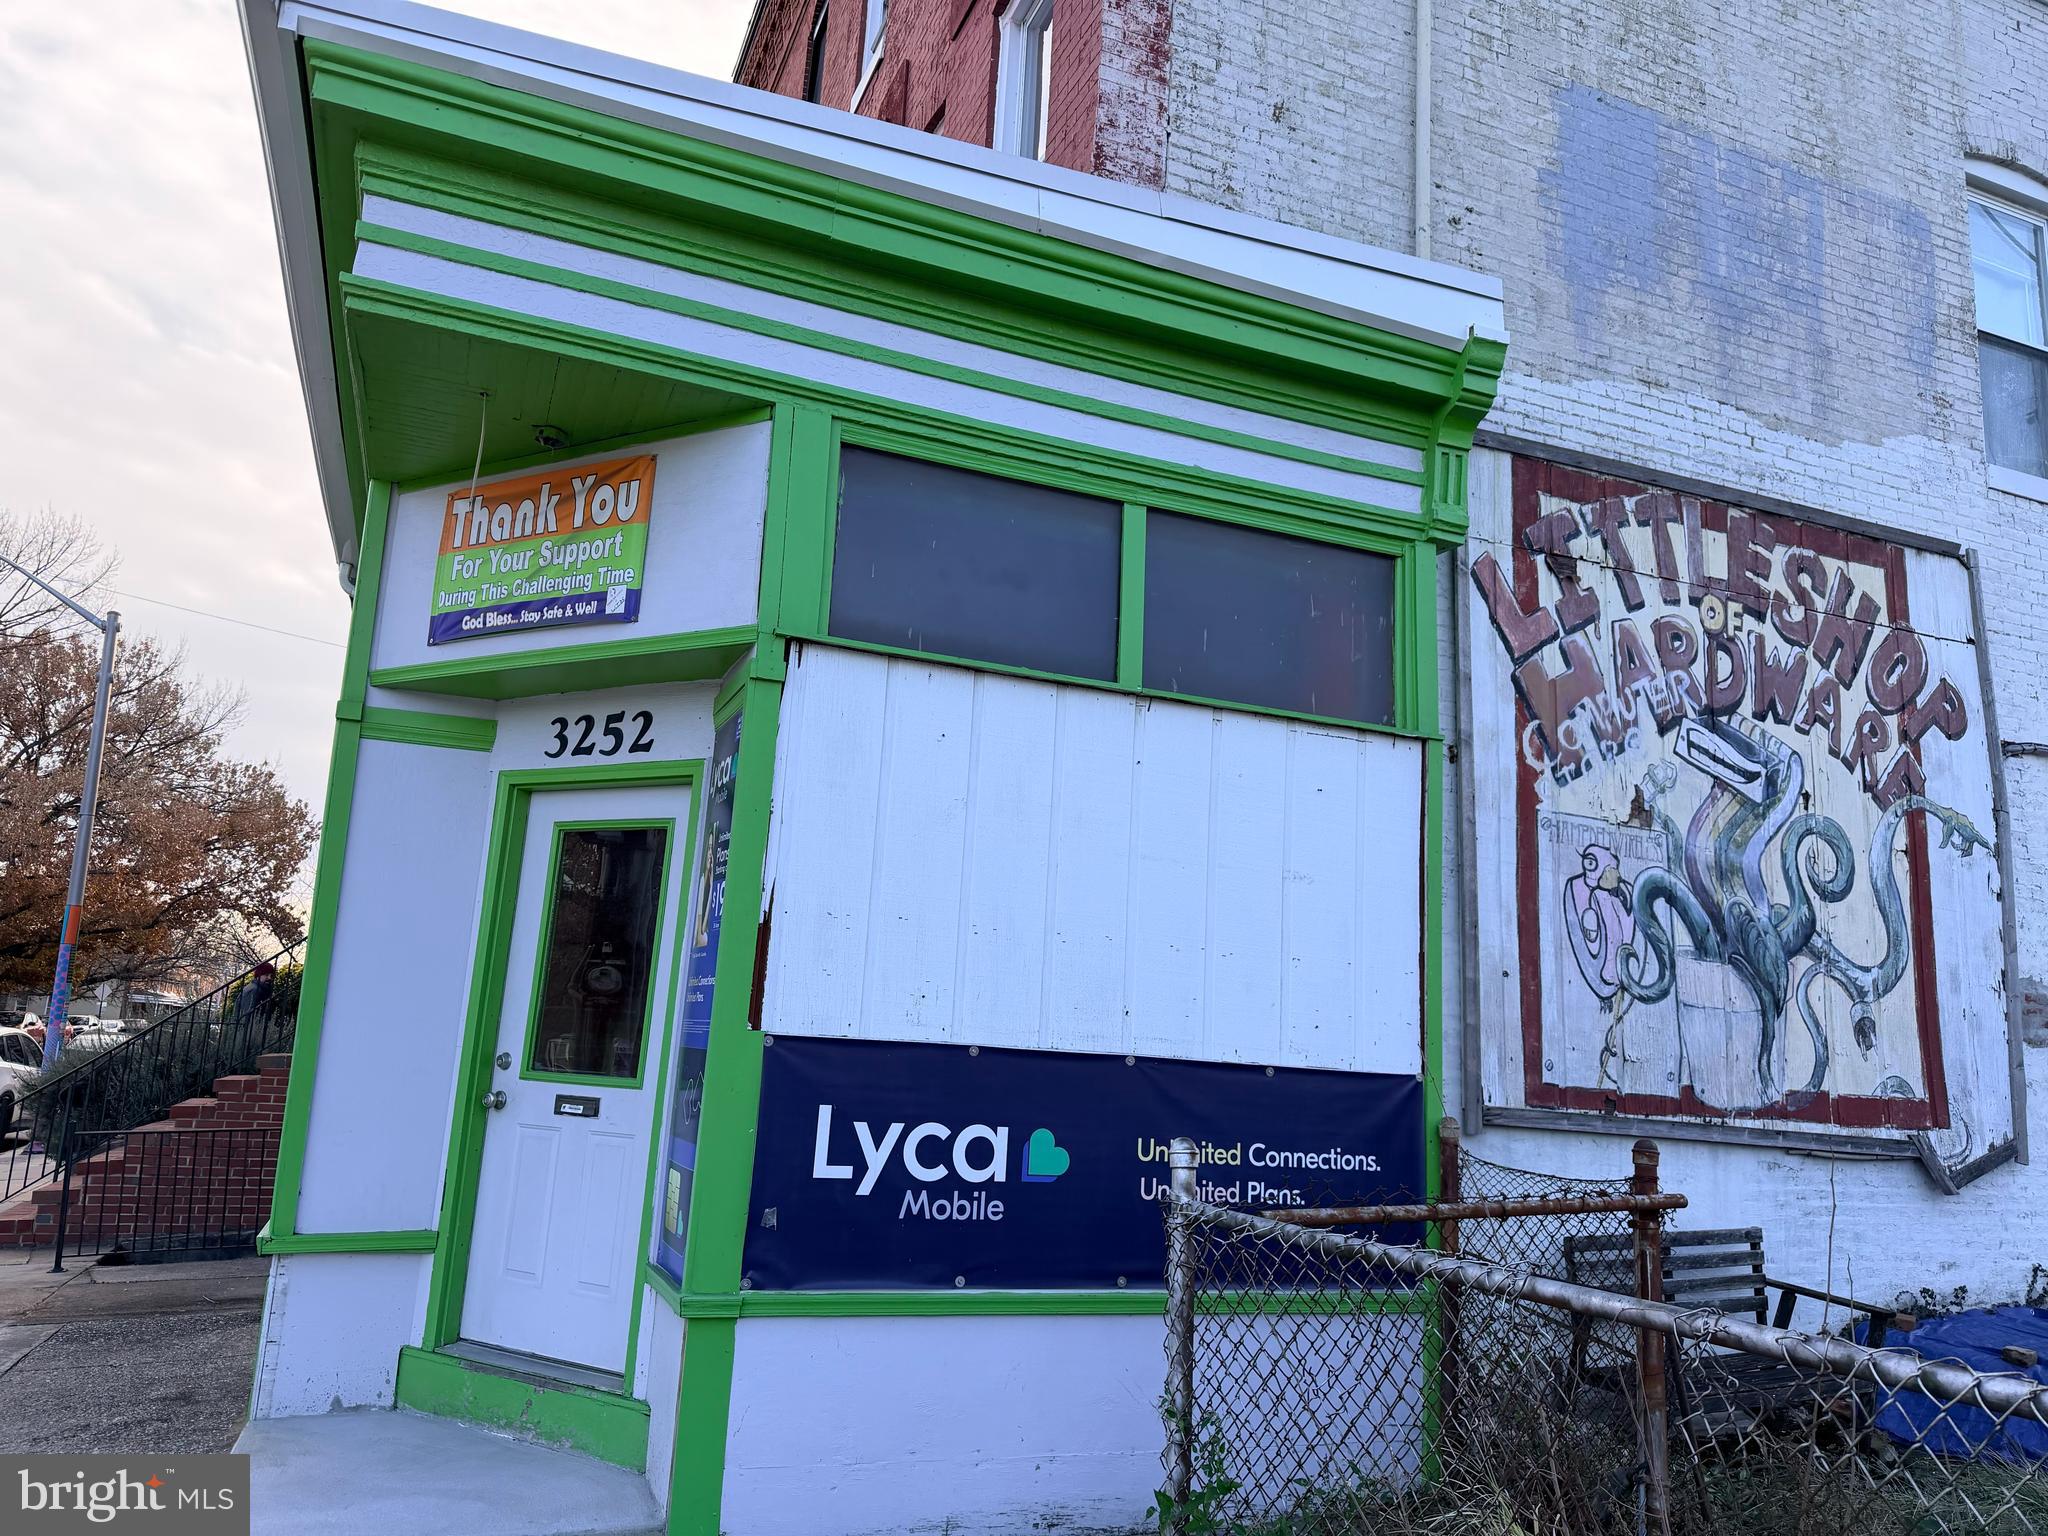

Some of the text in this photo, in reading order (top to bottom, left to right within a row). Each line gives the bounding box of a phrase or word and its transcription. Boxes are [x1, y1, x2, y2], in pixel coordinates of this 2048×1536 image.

[451, 473, 641, 549] Thank You
[451, 529, 624, 580] For Your Support
[438, 566, 635, 609] During This Challenging Time
[462, 612, 484, 631] God
[520, 609, 542, 624] Stay
[542, 605, 563, 620] Safe
[565, 603, 574, 616] &
[575, 600, 598, 616] Well
[1471, 492, 1969, 743] LITTLE SHOP
[1699, 594, 1744, 639] OF
[544, 710, 655, 759] 3252
[1511, 613, 1926, 814] HARDWARE
[812, 1104, 1010, 1196] Lyca
[1137, 1137, 1381, 1171] United Connections.
[898, 1189, 1004, 1221] Mobile
[1140, 1177, 1306, 1205] United Plans.
